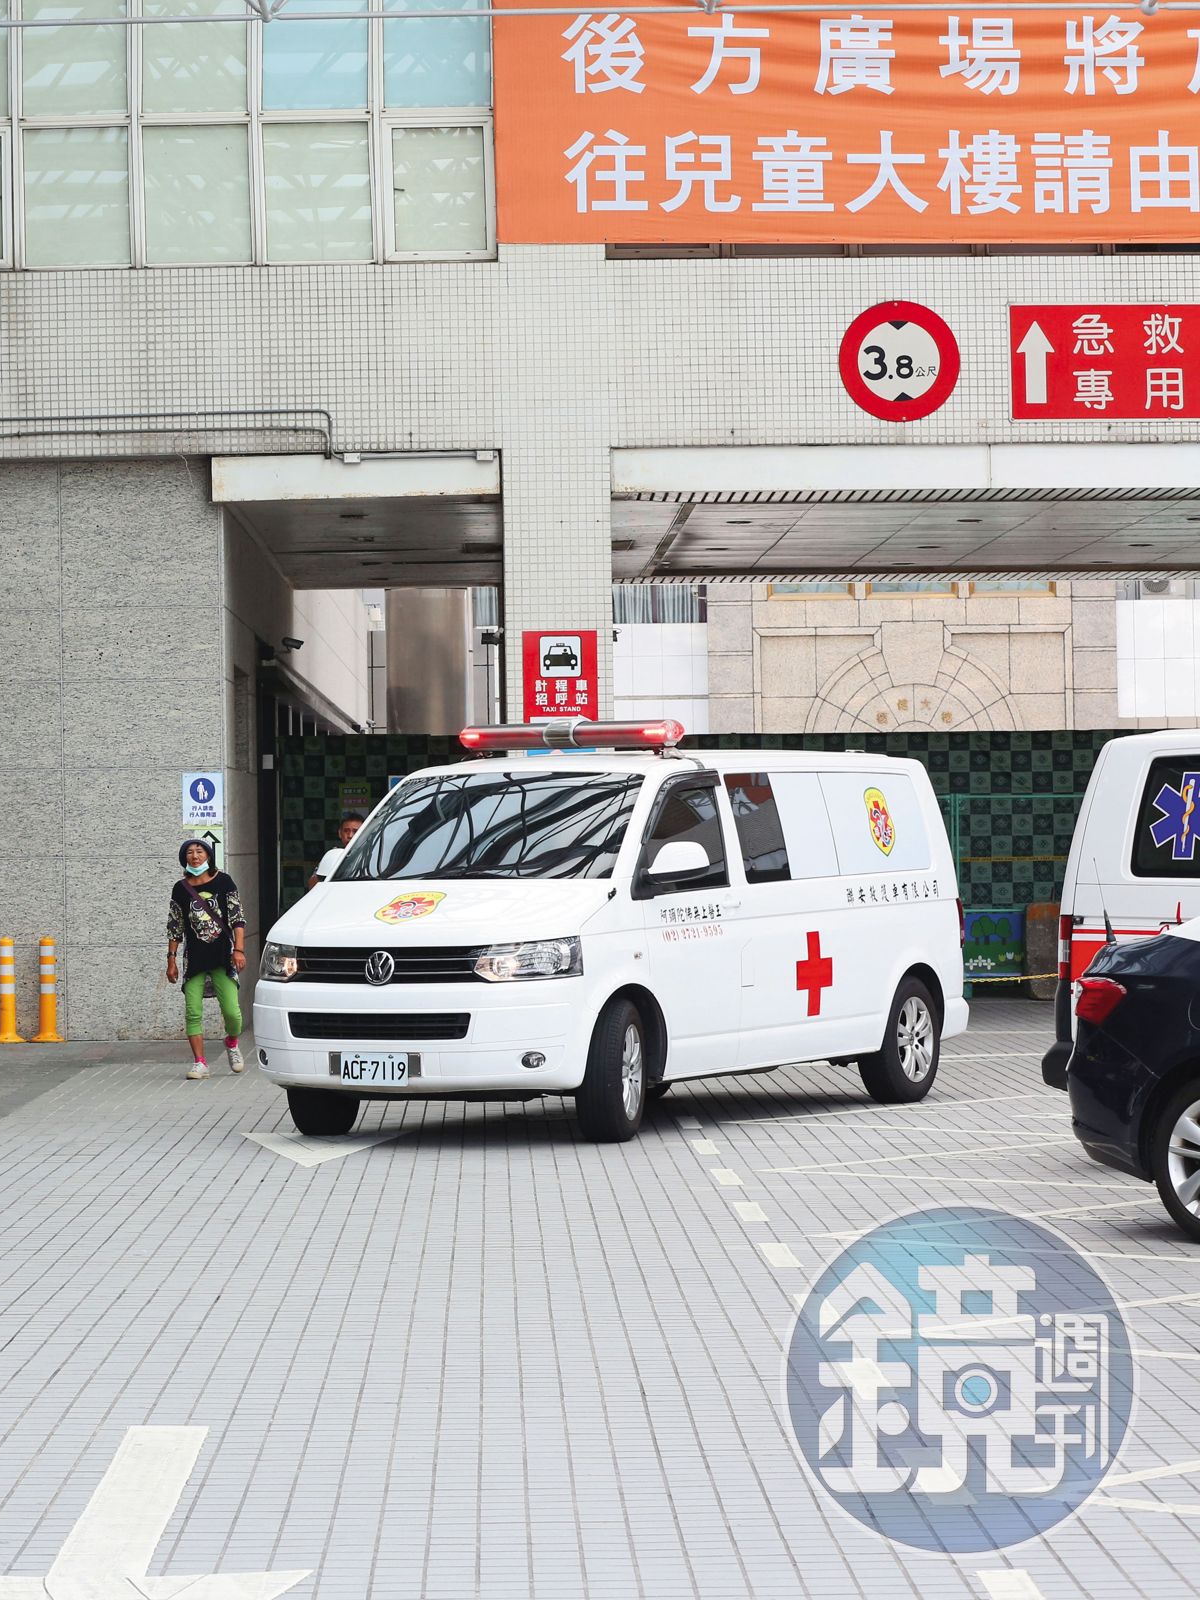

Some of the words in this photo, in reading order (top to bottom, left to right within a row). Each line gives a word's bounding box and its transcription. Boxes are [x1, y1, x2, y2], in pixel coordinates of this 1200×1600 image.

[561, 13, 1200, 95] 後方廣場將
[563, 129, 1200, 214] 往兒童大樓請由
[1072, 314, 1184, 355] 急救
[1072, 368, 1184, 410] 專用
[535, 680, 588, 692] 計程車
[535, 693, 588, 705] 招呼站
